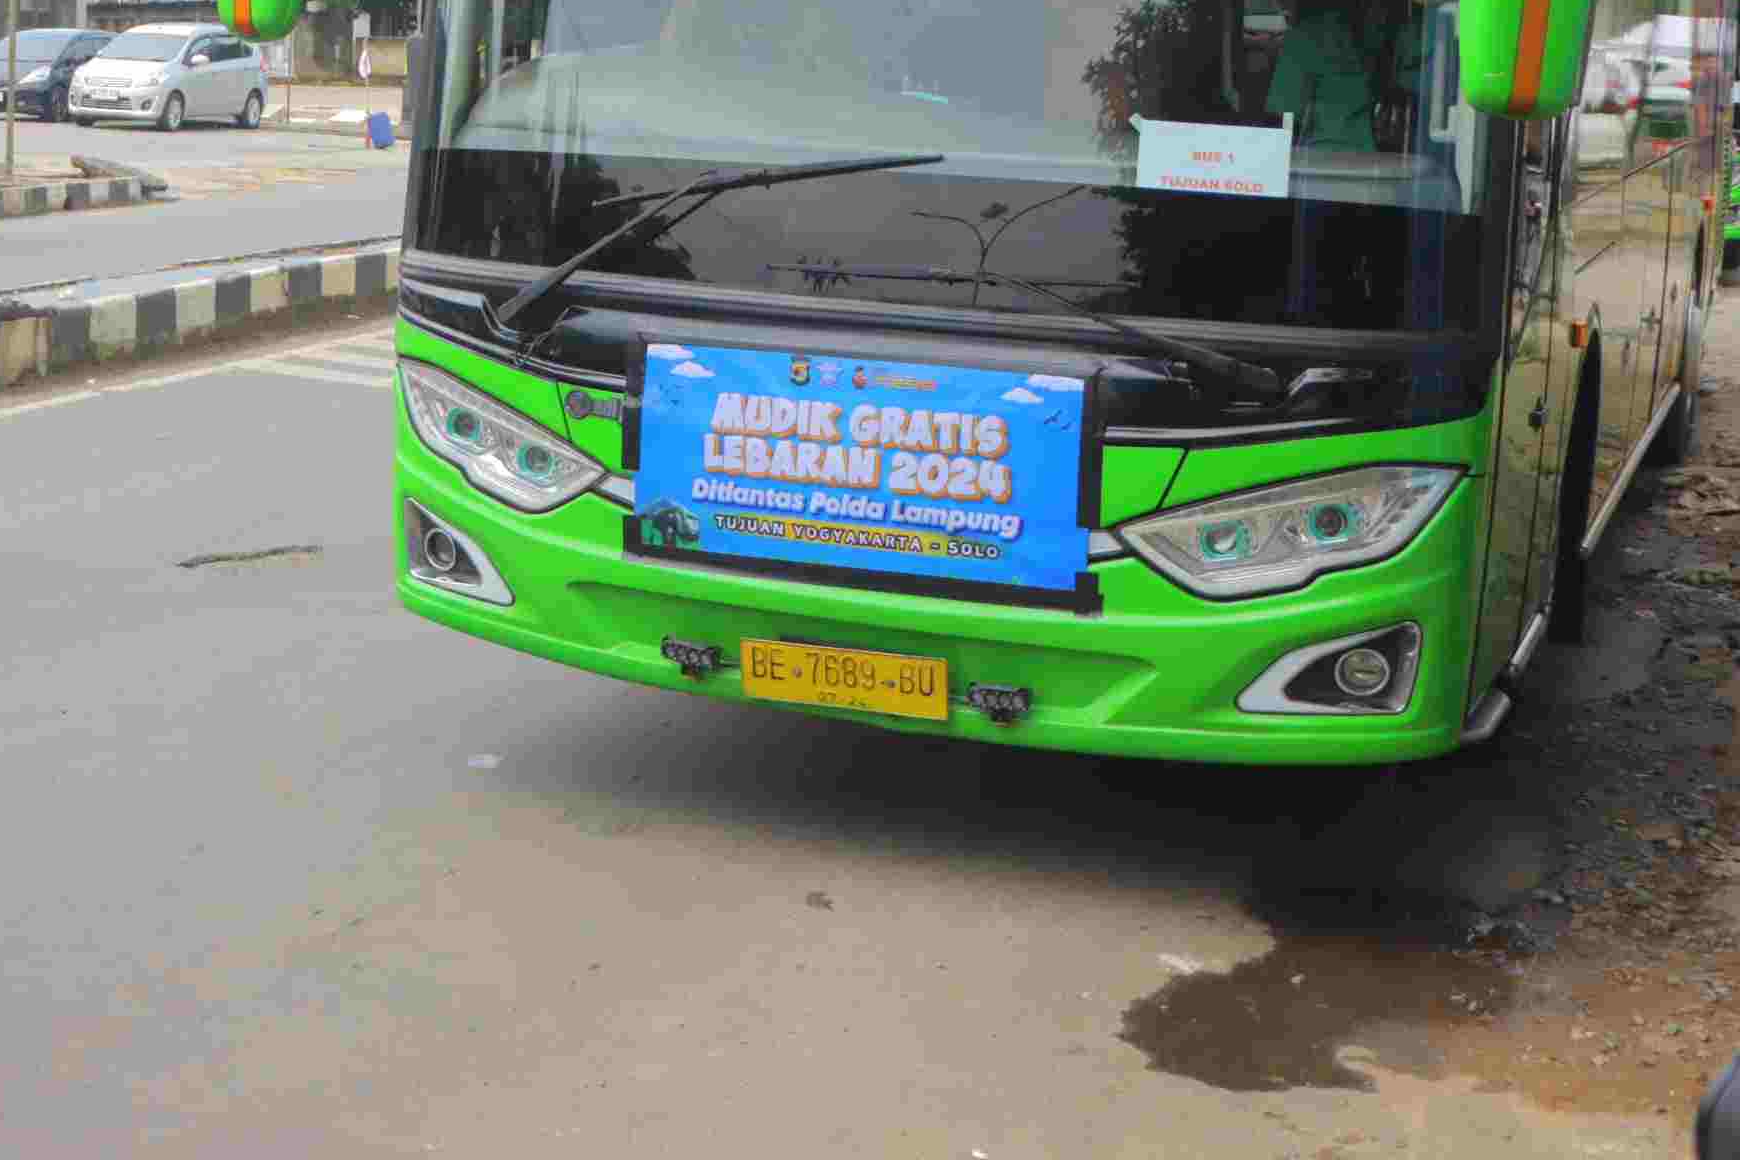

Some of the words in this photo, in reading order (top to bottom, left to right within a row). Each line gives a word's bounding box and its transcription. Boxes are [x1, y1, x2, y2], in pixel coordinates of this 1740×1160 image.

[1161, 175, 1220, 190] TUJUAN
[711, 392, 842, 444] MUDIK
[849, 403, 1010, 459] GRATIS
[703, 433, 882, 488] LEBARAN
[888, 451, 1013, 504] 2024
[714, 515, 786, 537] TUJUAN
[791, 522, 923, 553] YOGYAKARTA
[946, 542, 1002, 559] SOLO
[890, 499, 1023, 540] Lampung
[751, 647, 787, 681] BE
[805, 652, 877, 691] 7689
[898, 663, 936, 697] BU
